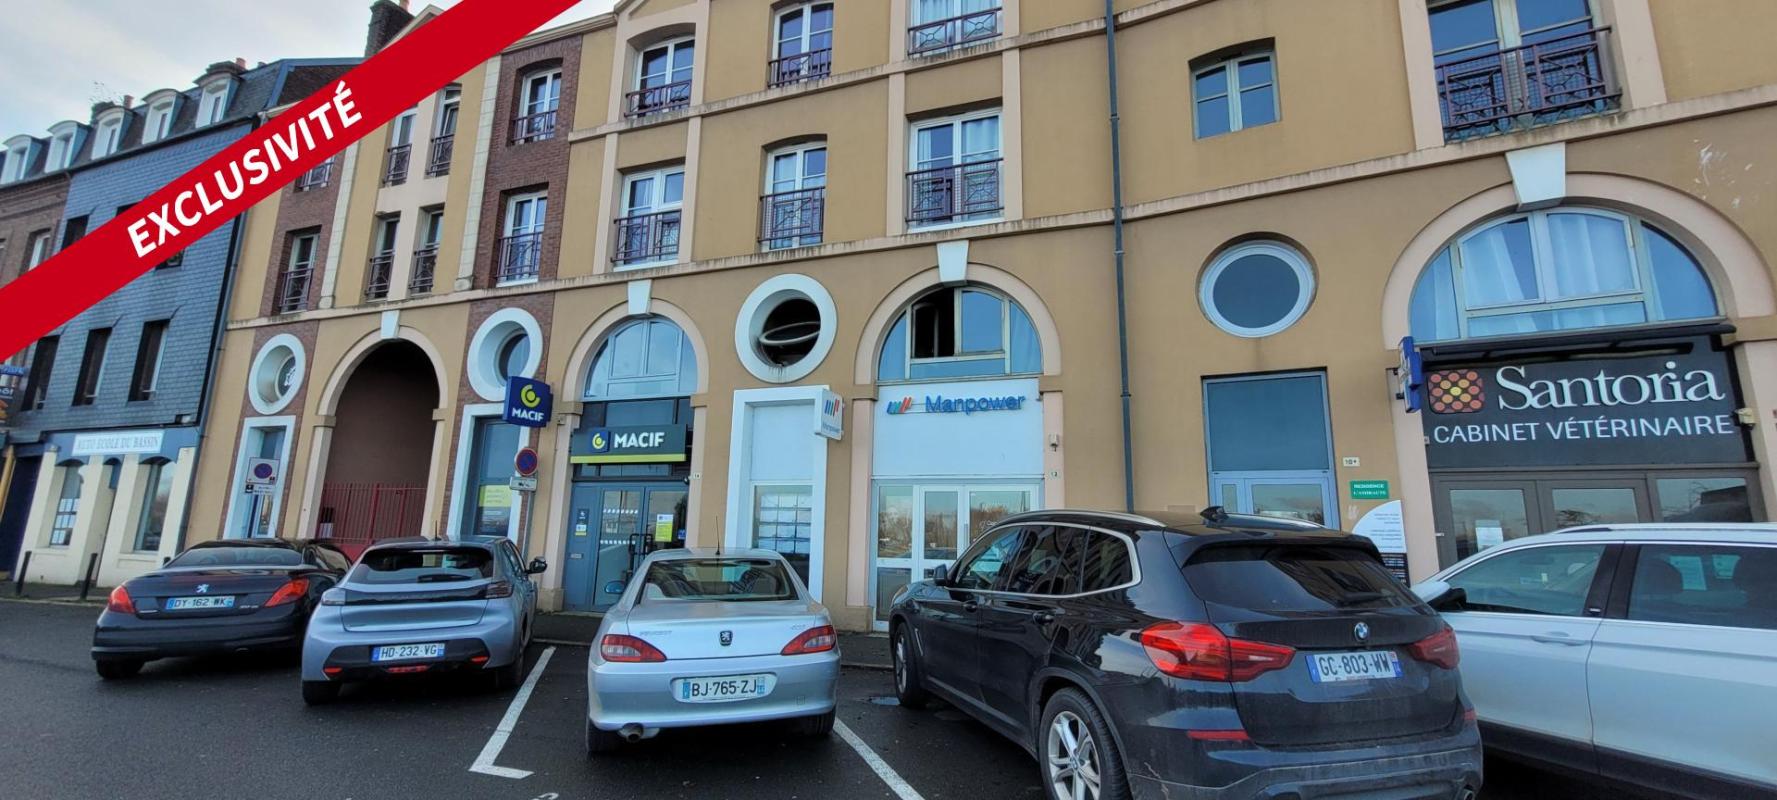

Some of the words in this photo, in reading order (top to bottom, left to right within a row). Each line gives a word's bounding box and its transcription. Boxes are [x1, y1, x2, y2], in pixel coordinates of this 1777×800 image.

[1496, 361, 1726, 411] Santoria
[511, 407, 545, 422] MACIF
[925, 395, 1026, 415] Manpower
[1433, 422, 1540, 444] CABINET
[1546, 414, 1734, 440] VÉTÉRINAIRE
[613, 431, 665, 449] MACIF
